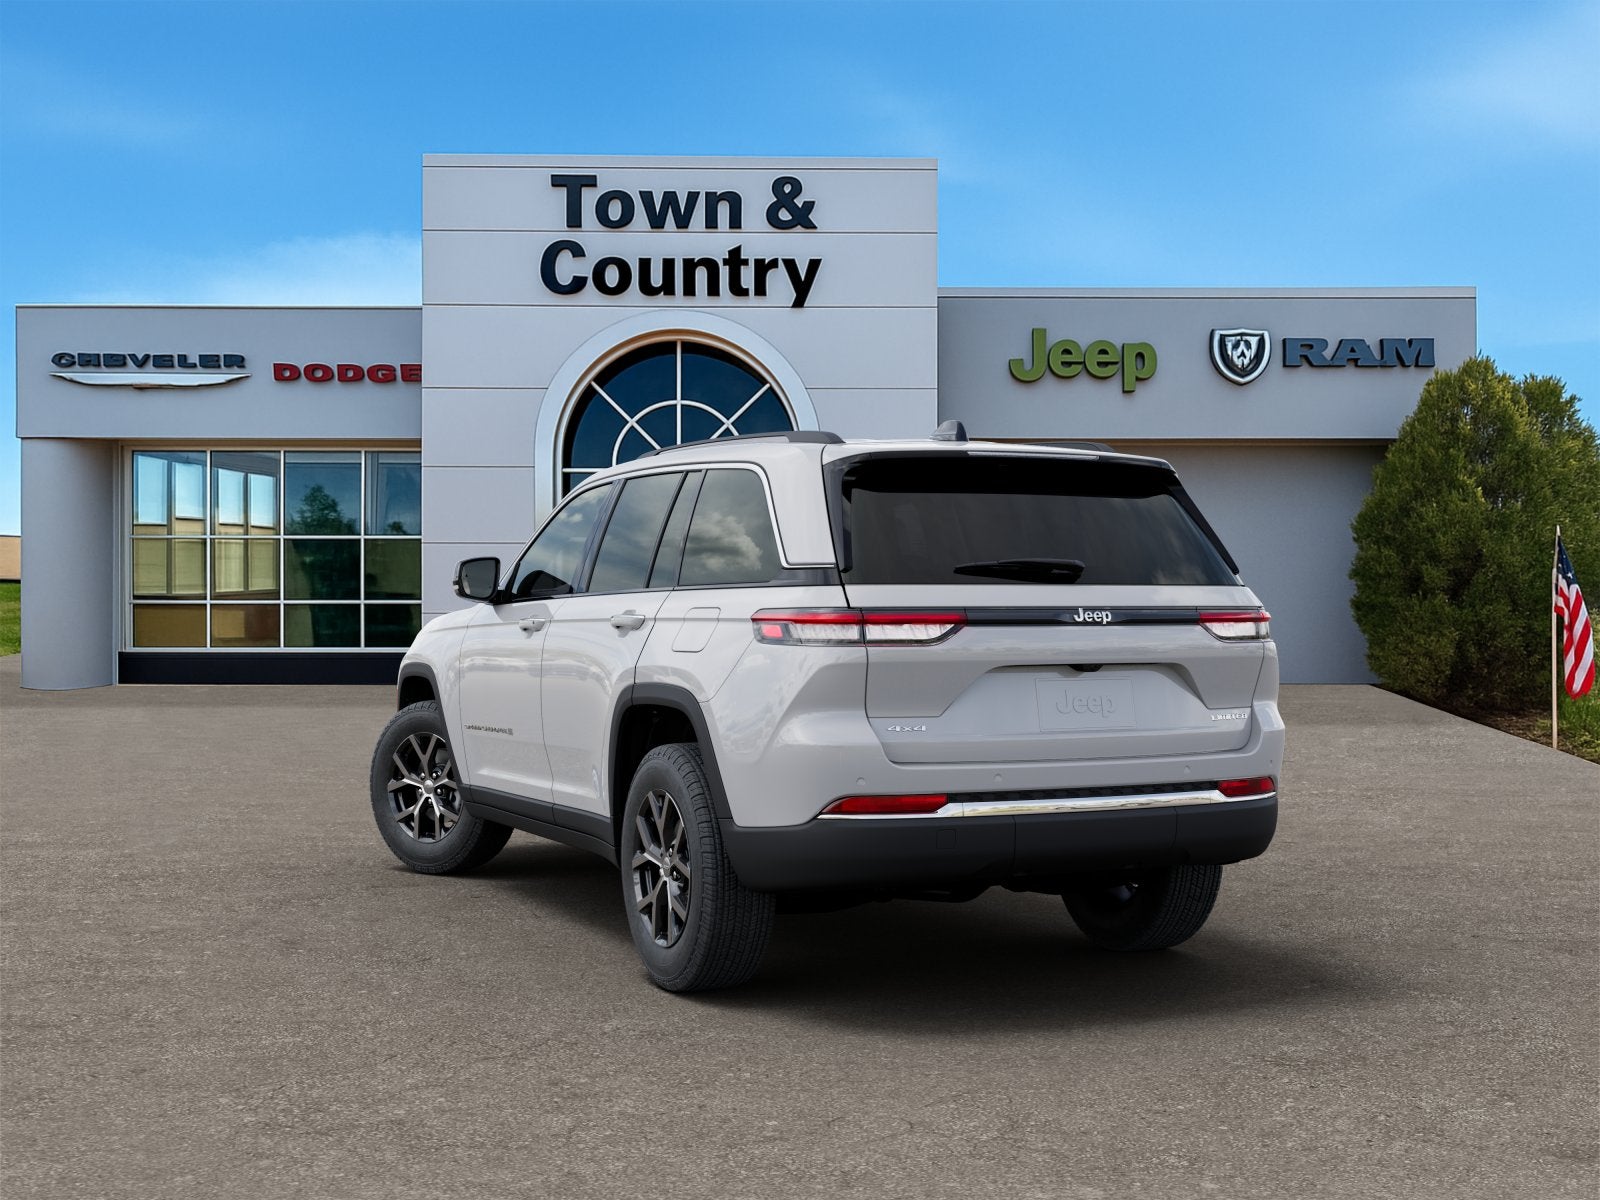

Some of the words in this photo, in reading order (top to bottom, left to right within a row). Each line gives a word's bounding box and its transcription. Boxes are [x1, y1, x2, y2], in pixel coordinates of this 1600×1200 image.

[550, 173, 743, 230] Town
[765, 175, 818, 230] &
[539, 239, 823, 308] Country
[1008, 327, 1159, 394] Jeep
[1282, 337, 1436, 369] RAM
[272, 362, 423, 384] DODGE
[1073, 607, 1112, 625] Jeep
[1055, 687, 1117, 719] Jeep
